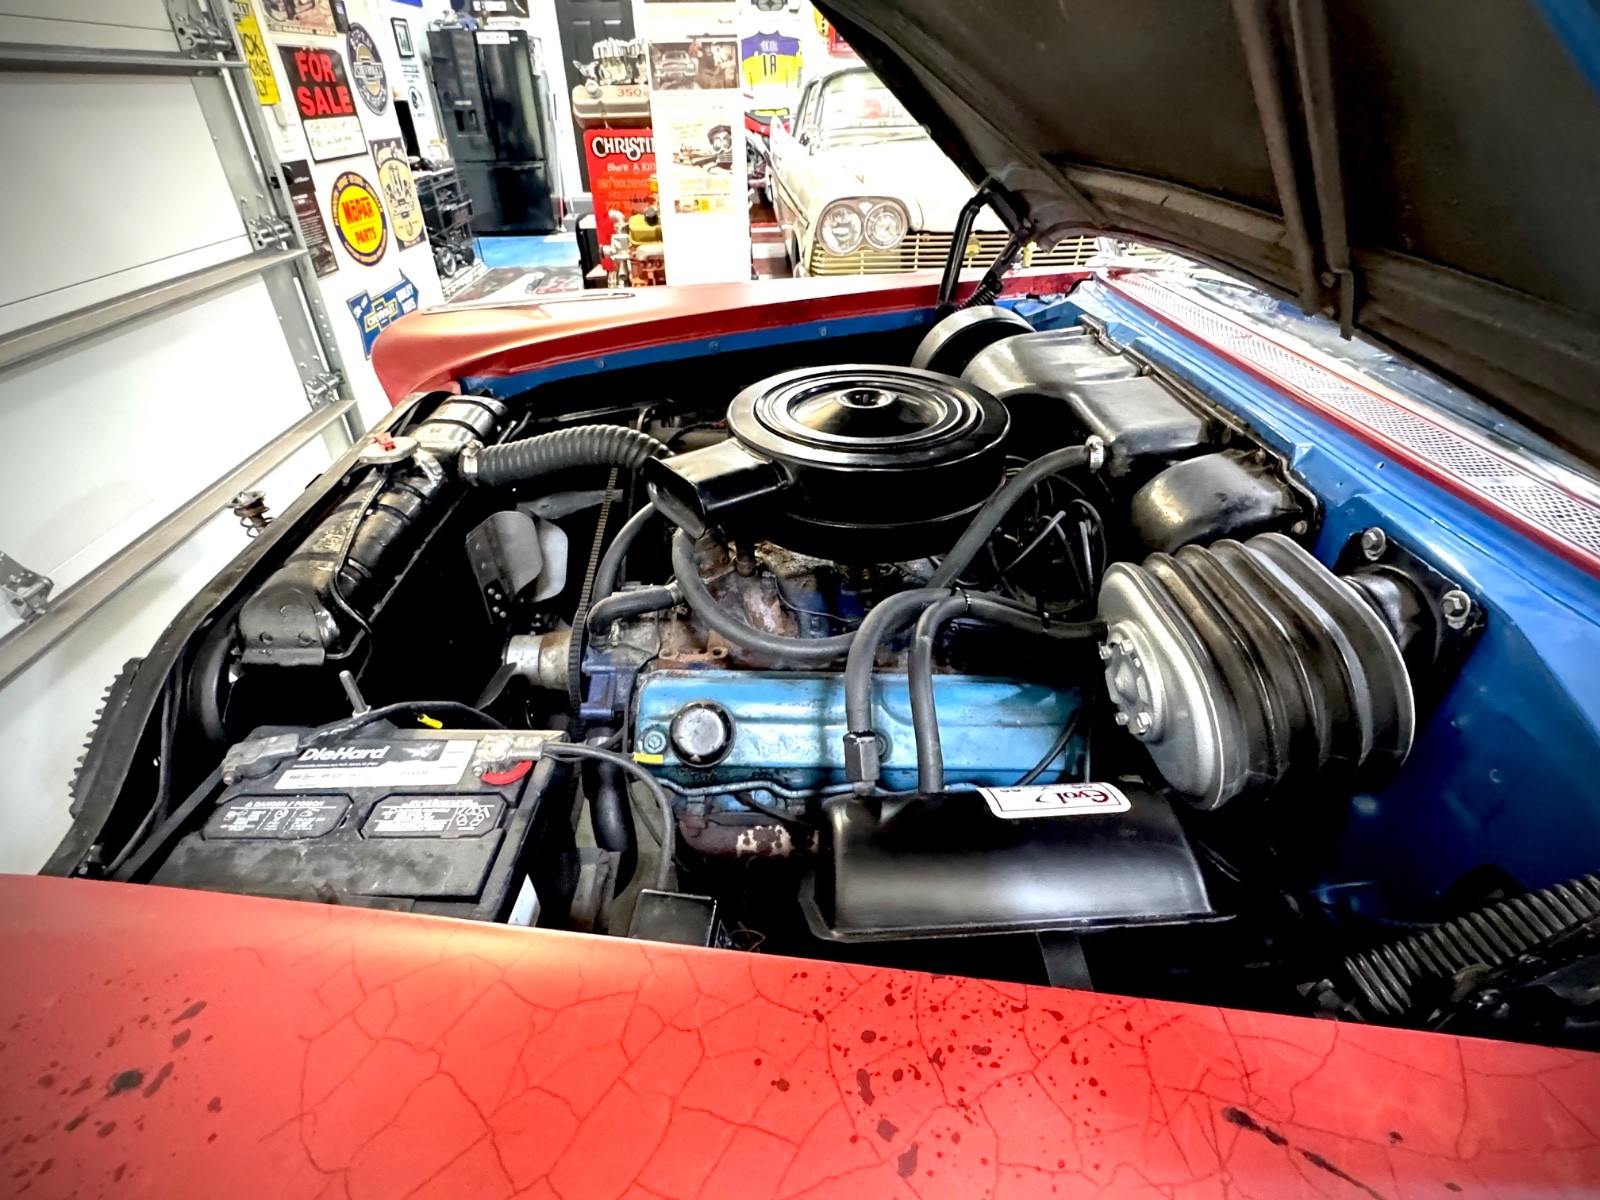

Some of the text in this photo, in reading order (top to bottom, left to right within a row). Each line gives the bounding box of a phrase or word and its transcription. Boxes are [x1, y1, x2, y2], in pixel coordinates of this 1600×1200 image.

[294, 52, 336, 82] FOR
[297, 86, 353, 116] SALE
[618, 88, 641, 97] 350
[633, 162, 641, 171] A
[342, 197, 375, 224] MOPAR
[354, 227, 377, 246] PARTS
[299, 746, 390, 761] DieHard
